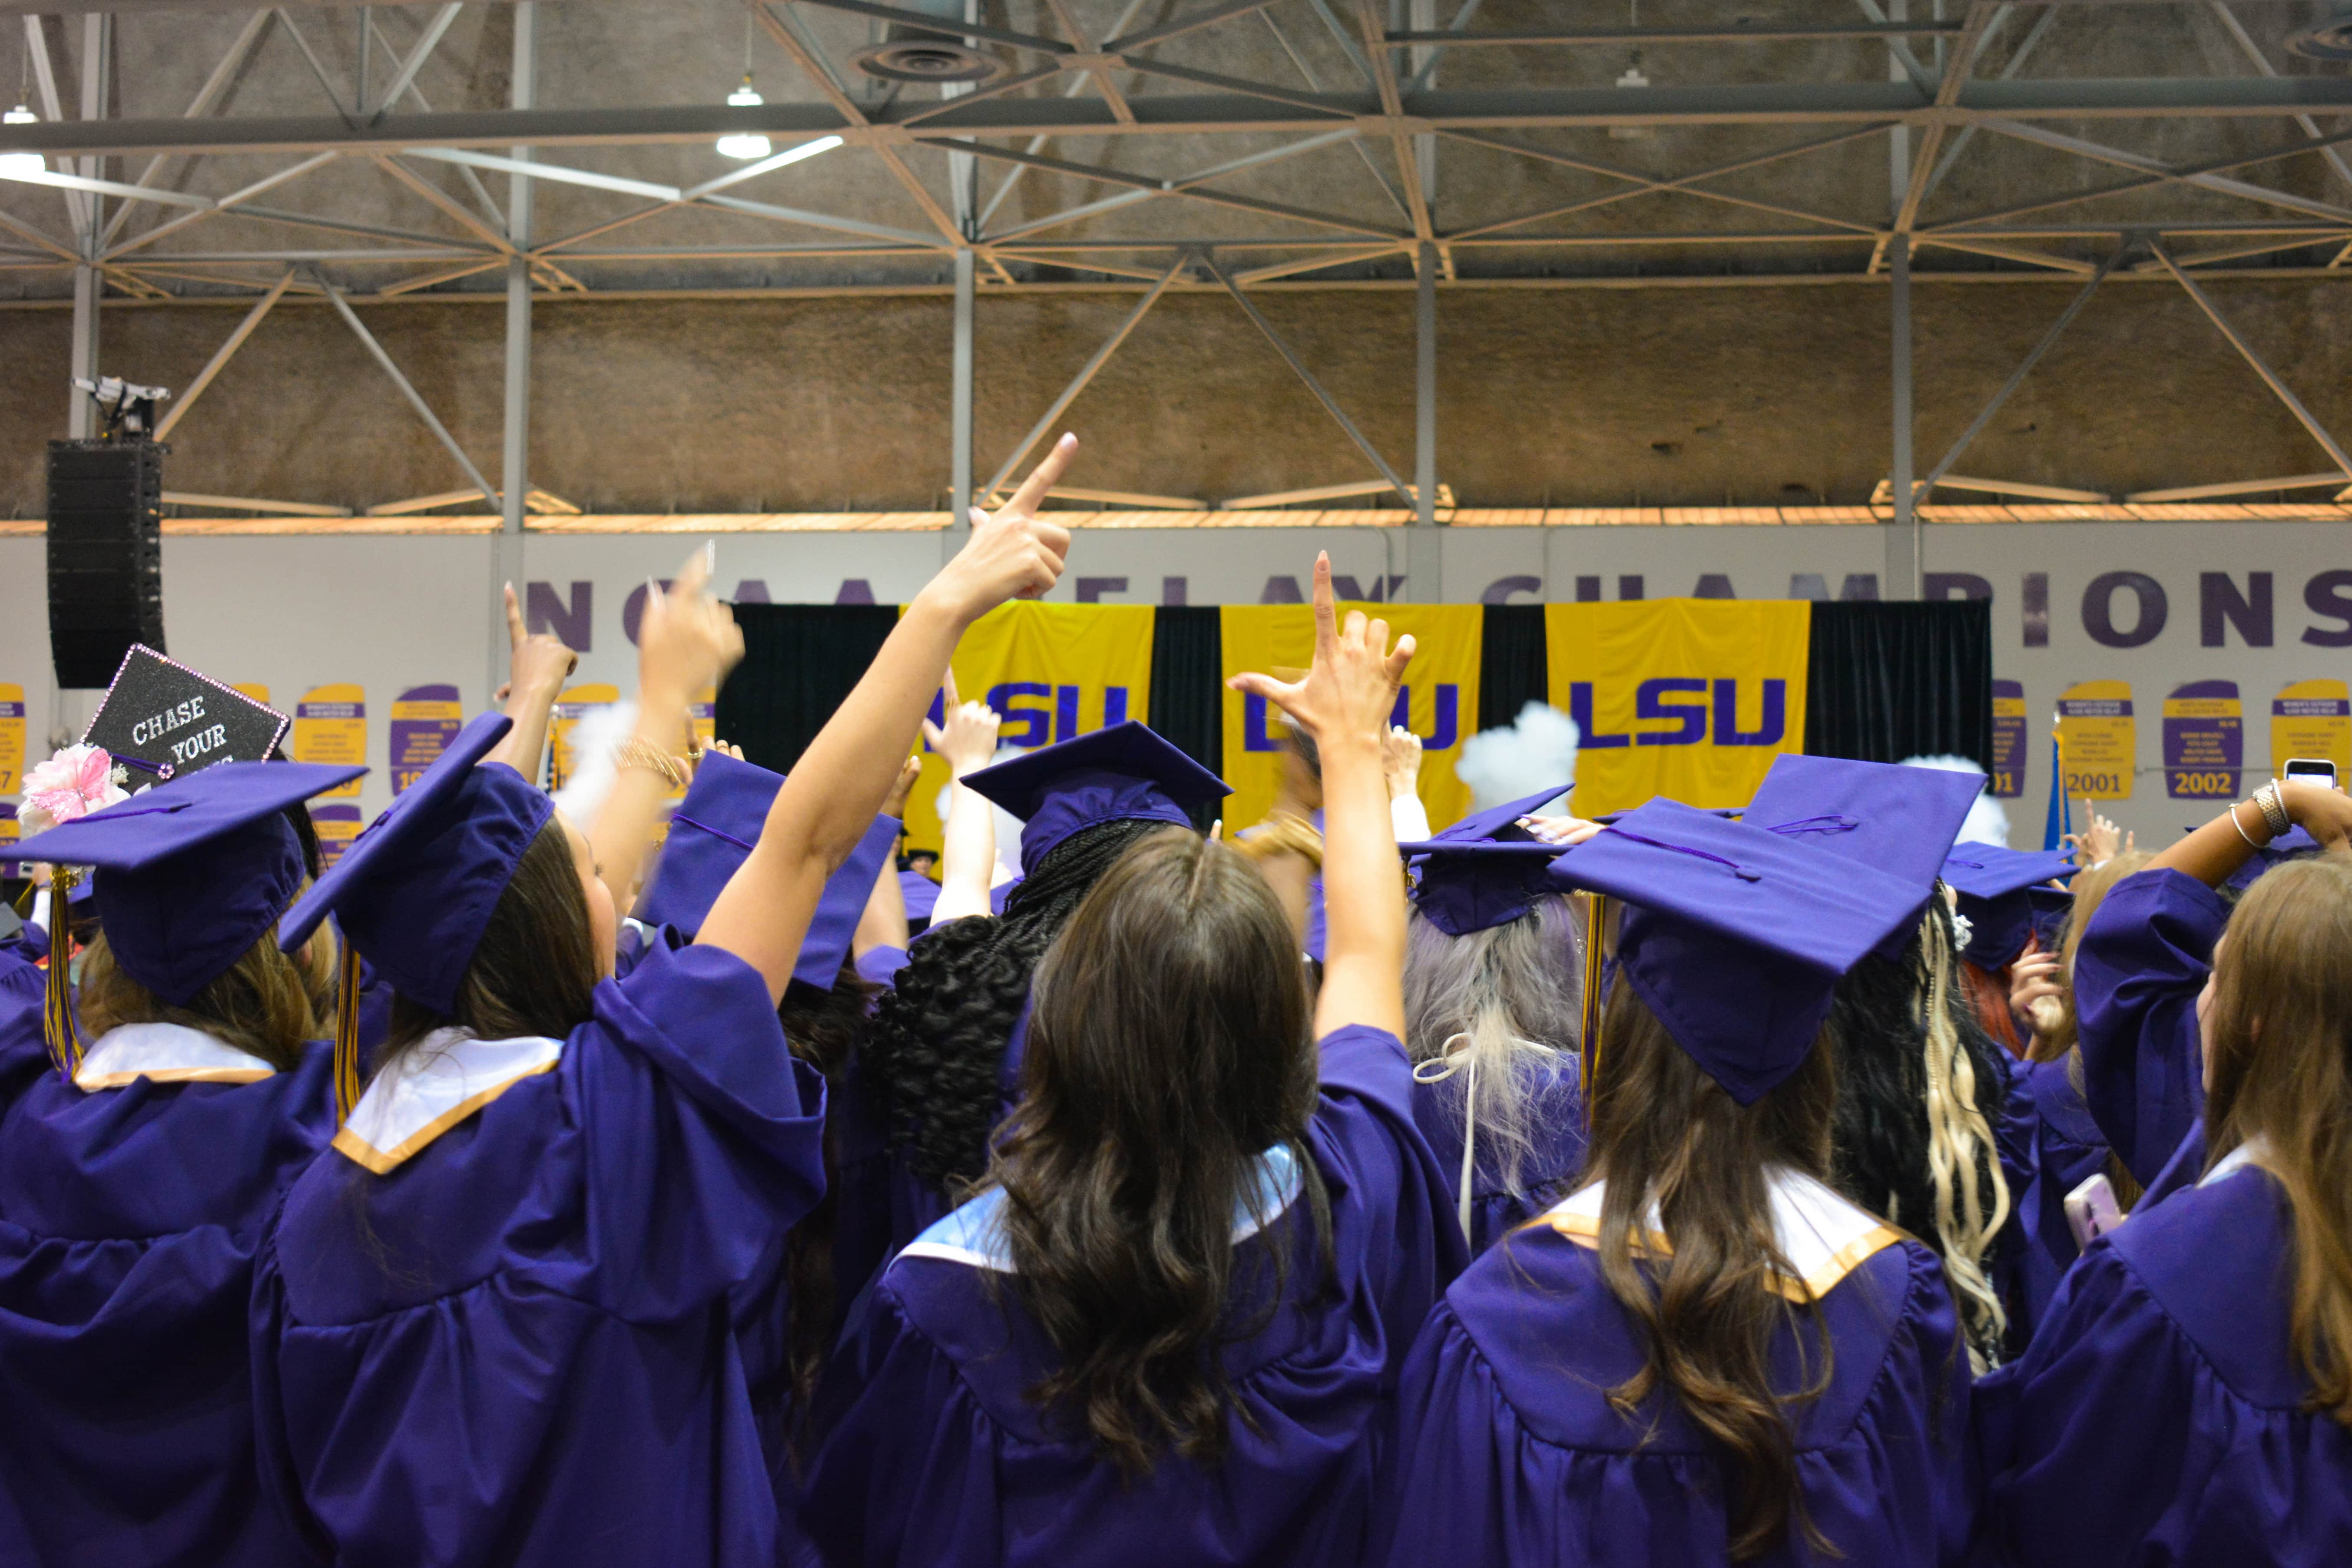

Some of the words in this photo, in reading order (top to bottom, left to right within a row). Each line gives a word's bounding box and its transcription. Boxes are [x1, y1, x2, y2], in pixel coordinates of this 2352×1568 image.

[133, 696, 205, 746] CHASE
[1244, 684, 1459, 751] LU
[1570, 678, 1786, 749] LSU
[171, 723, 227, 764] YOUR
[2067, 773, 2120, 792] 2001
[2175, 773, 2231, 793] 2002
